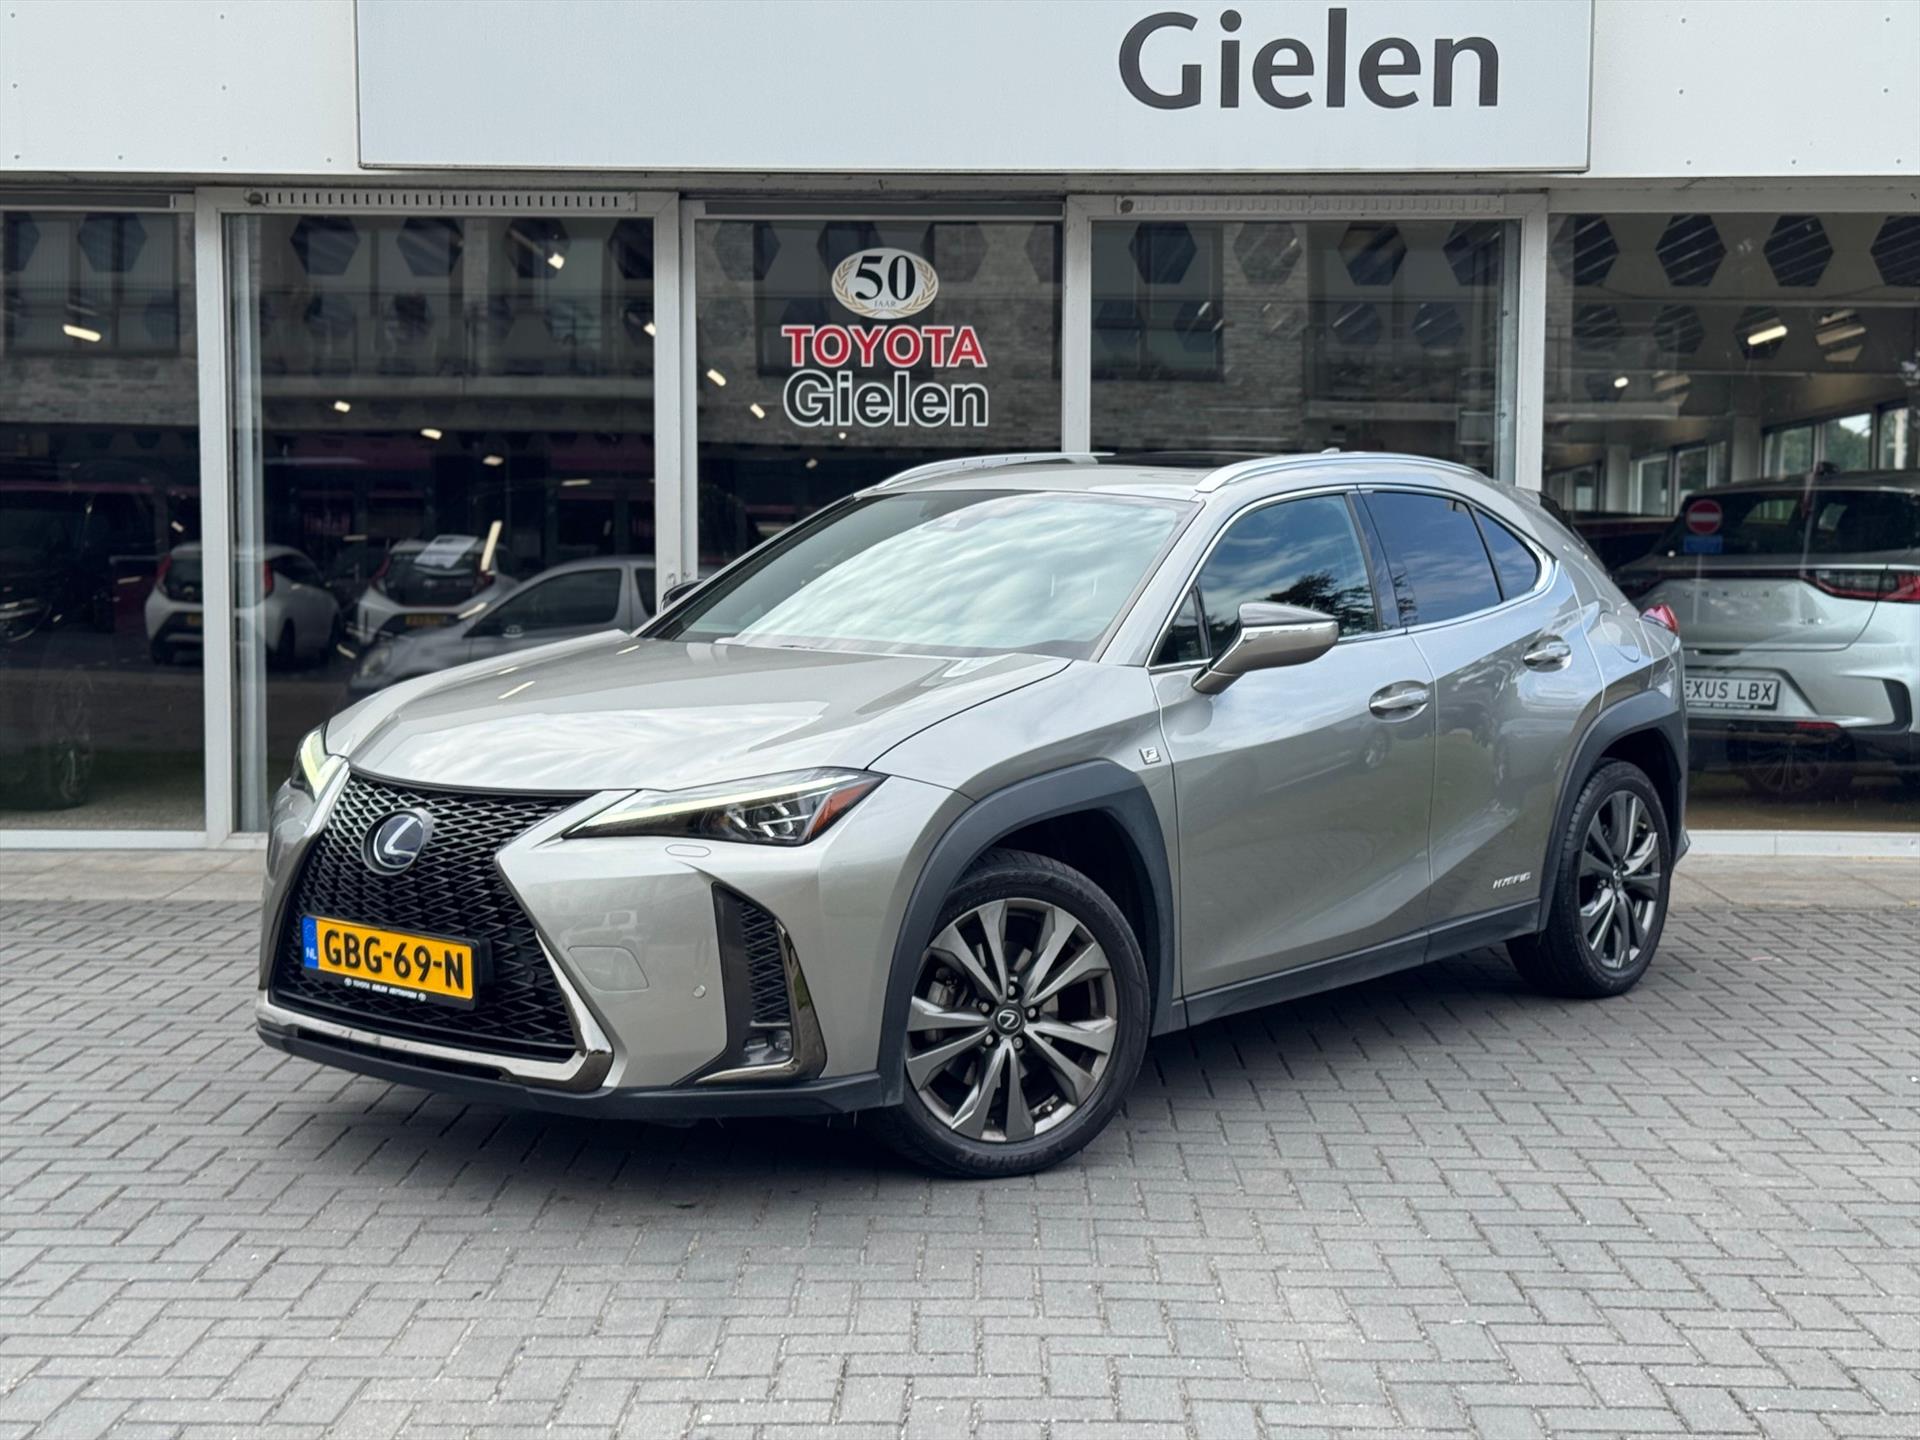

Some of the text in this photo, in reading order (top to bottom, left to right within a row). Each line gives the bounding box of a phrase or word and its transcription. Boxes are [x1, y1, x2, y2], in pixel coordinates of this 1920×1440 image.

[1118, 7, 1499, 110] Gielen
[855, 255, 916, 301] 50
[781, 325, 988, 368] TOYOTA
[783, 369, 989, 427] Gielen
[1737, 682, 1773, 701] LBX
[305, 947, 317, 960] NL
[324, 929, 464, 990] GBG-69-N
